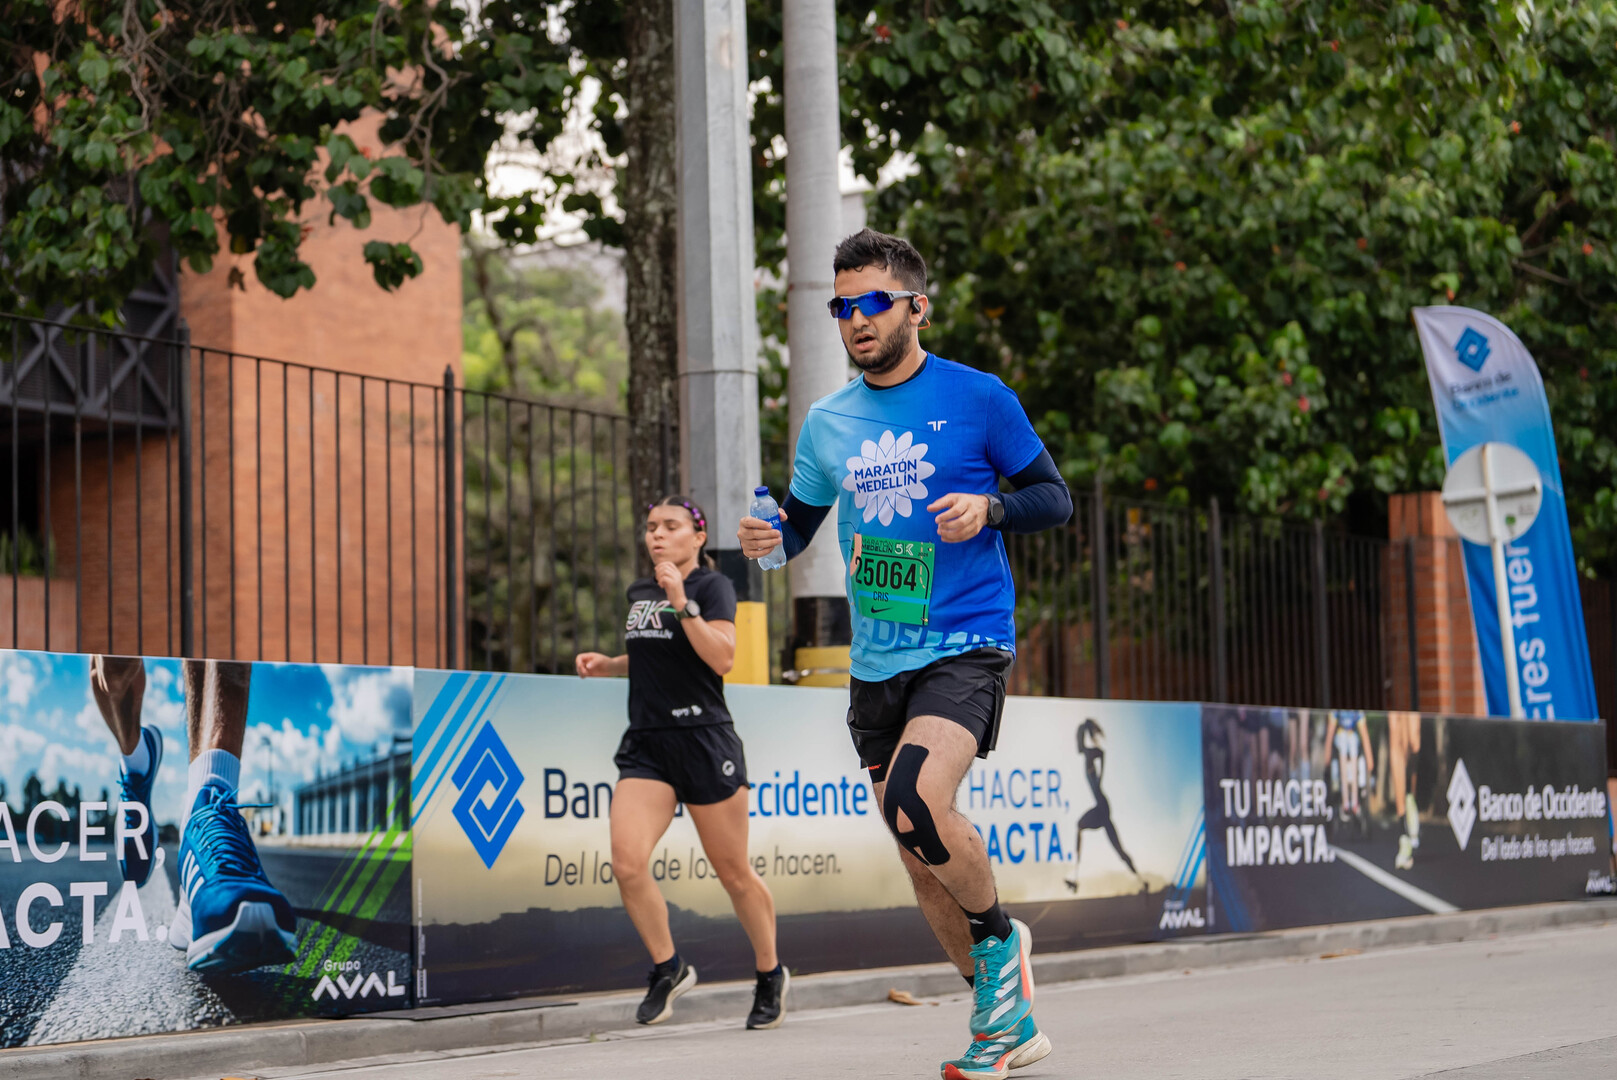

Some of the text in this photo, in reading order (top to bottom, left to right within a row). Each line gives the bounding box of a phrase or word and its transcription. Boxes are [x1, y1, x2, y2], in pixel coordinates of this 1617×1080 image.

[854, 458, 917, 480] MARATÓN
[855, 472, 917, 494] MEDELLÍN
[894, 543, 914, 557] 5K
[855, 556, 917, 592] 25064
[873, 591, 889, 602] CRIS
[626, 600, 671, 631] 5K
[544, 768, 868, 819] Ban cidente
[969, 769, 1070, 814] HACER,
[1220, 779, 1333, 822] TU HACER,
[1478, 784, 1606, 821] Banco de Occidente
[974, 823, 1072, 865] ACTA.
[1226, 824, 1336, 867] IMPACTA.
[545, 850, 585, 886] Del
[652, 848, 681, 880] de
[773, 845, 842, 877] hacen.
[1159, 907, 1205, 929] AVAL
[324, 960, 361, 972] Grupo
[311, 970, 406, 1001] AVAL
